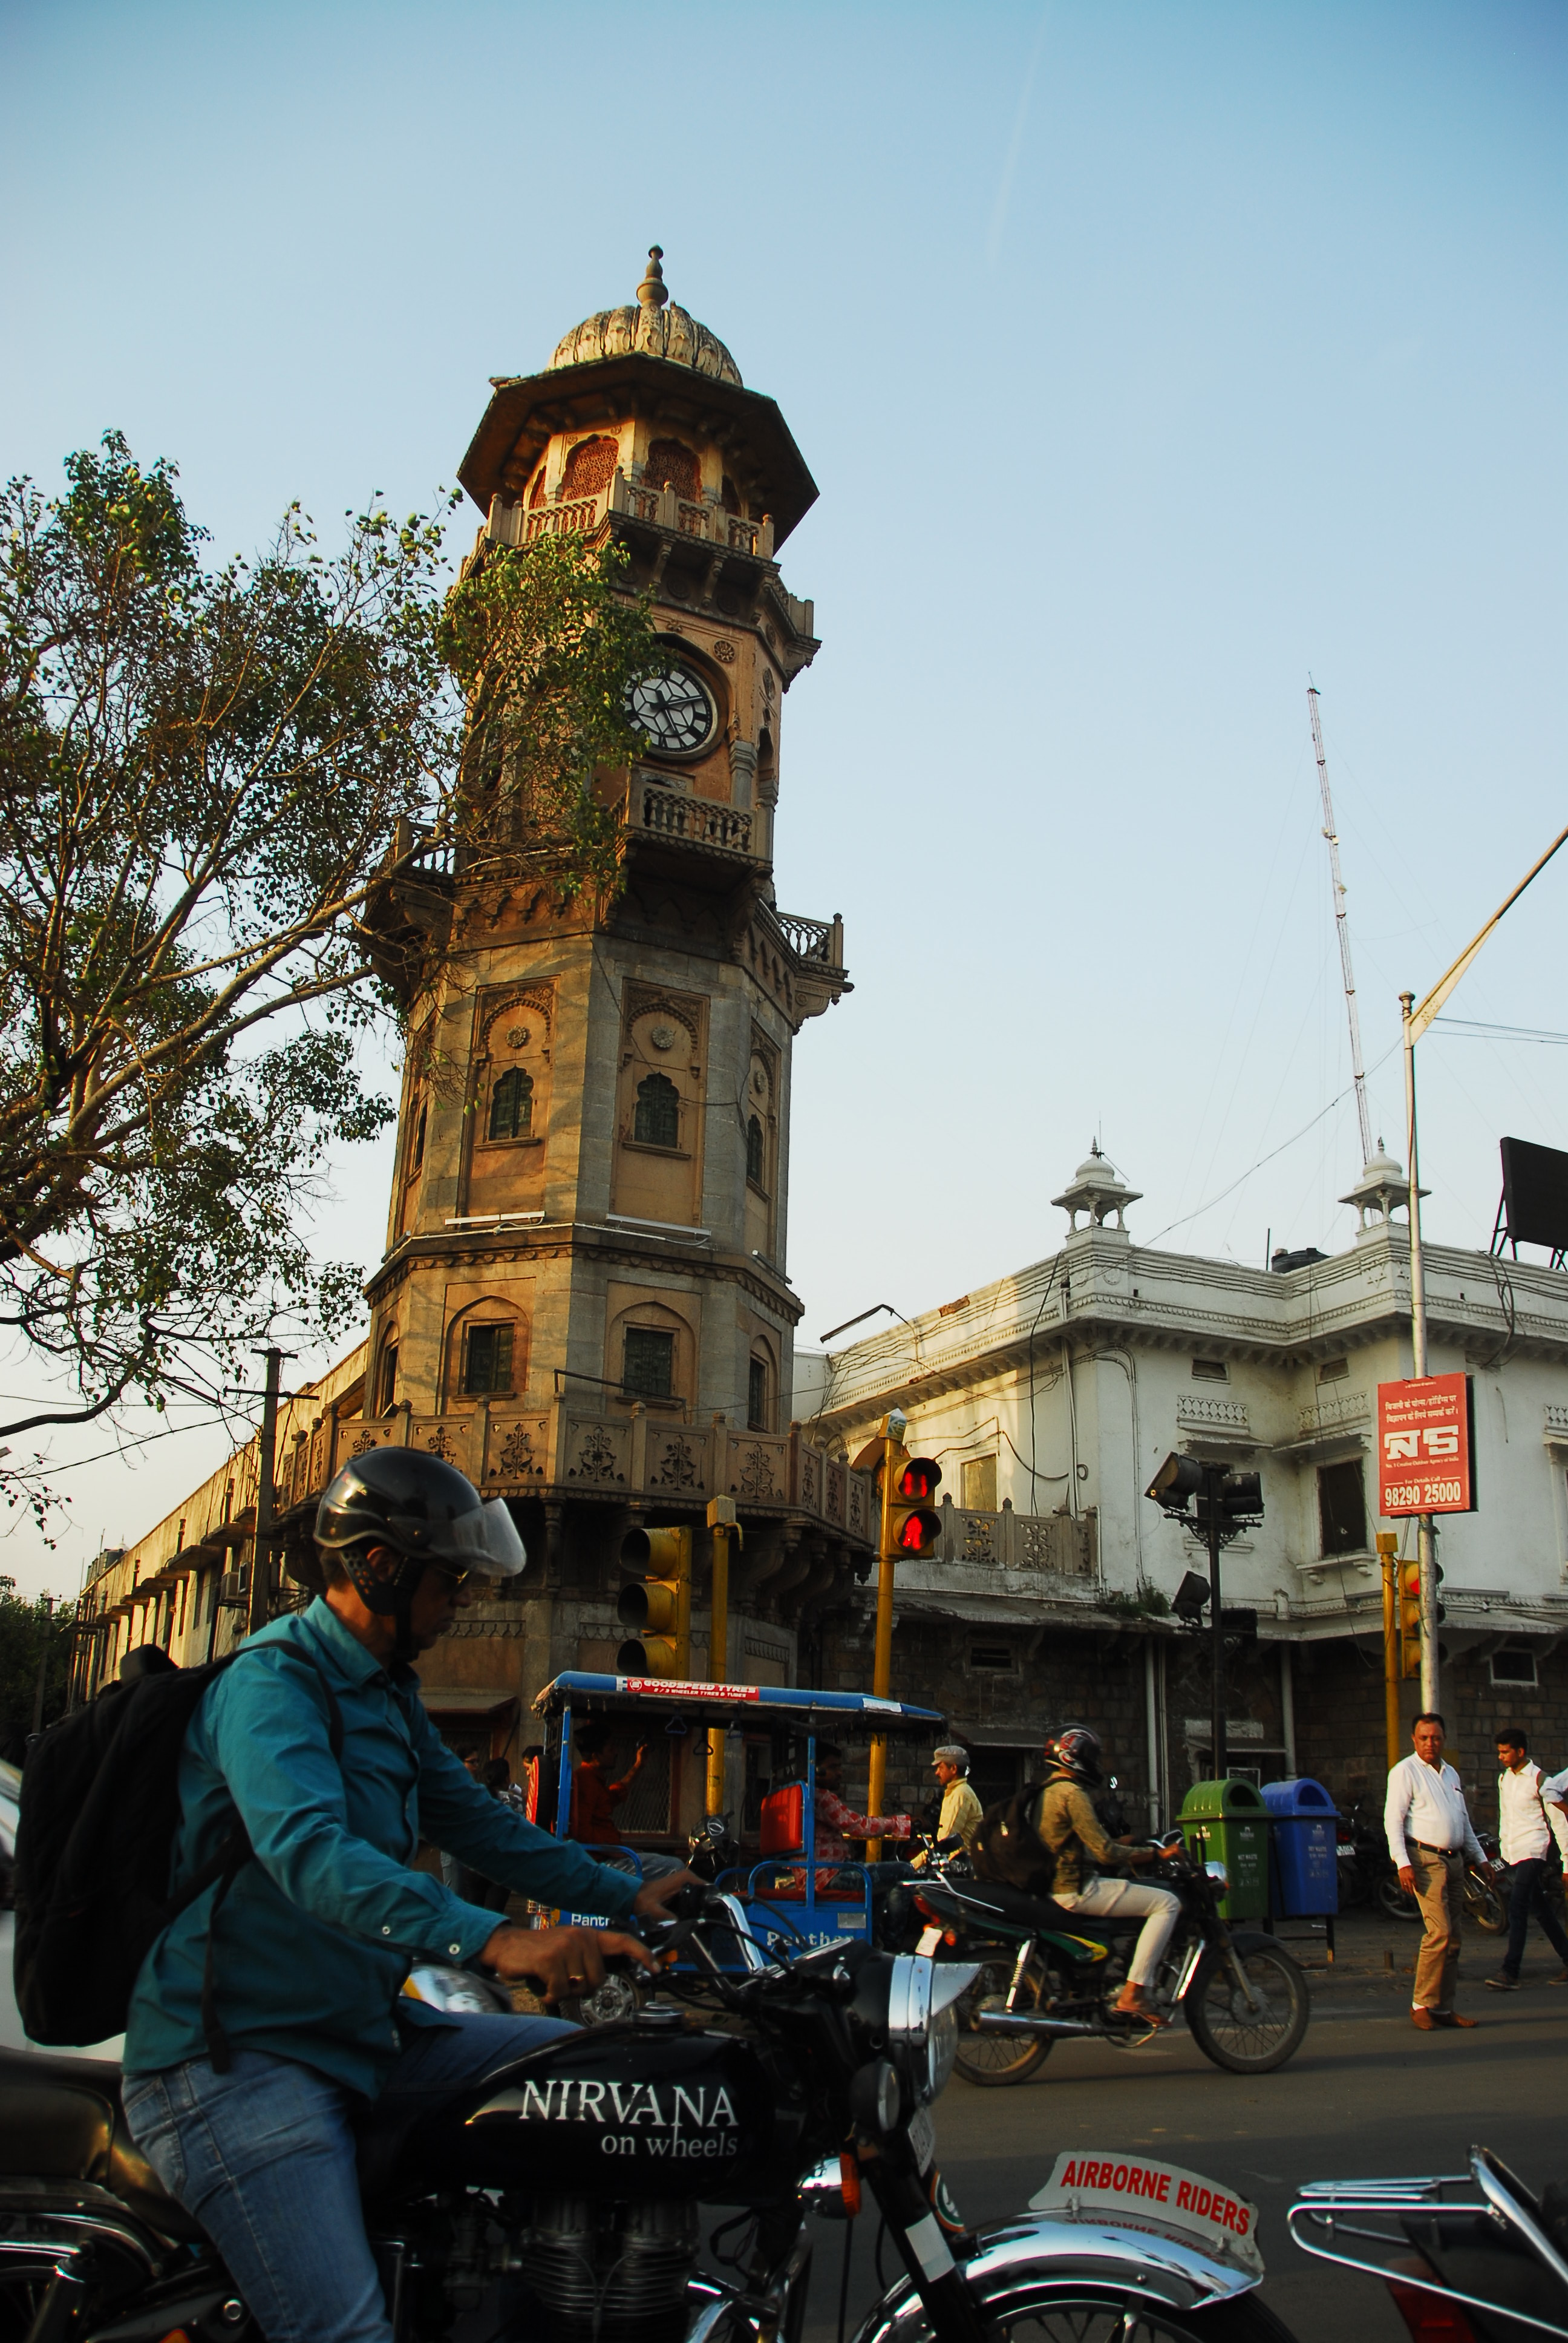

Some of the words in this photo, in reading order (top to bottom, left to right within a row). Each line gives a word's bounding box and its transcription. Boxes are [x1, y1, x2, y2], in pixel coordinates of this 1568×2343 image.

[1385, 1485, 1420, 1507] 98290
[1425, 1481, 1461, 1504] 25000
[644, 1680, 715, 1691] GOODSPEED
[519, 2080, 739, 2128] NIRVANA
[601, 2135, 636, 2155] on
[646, 2128, 737, 2158] wheels
[1060, 2161, 1172, 2203] AIRBORNE
[1176, 2181, 1250, 2236] RIDERS
